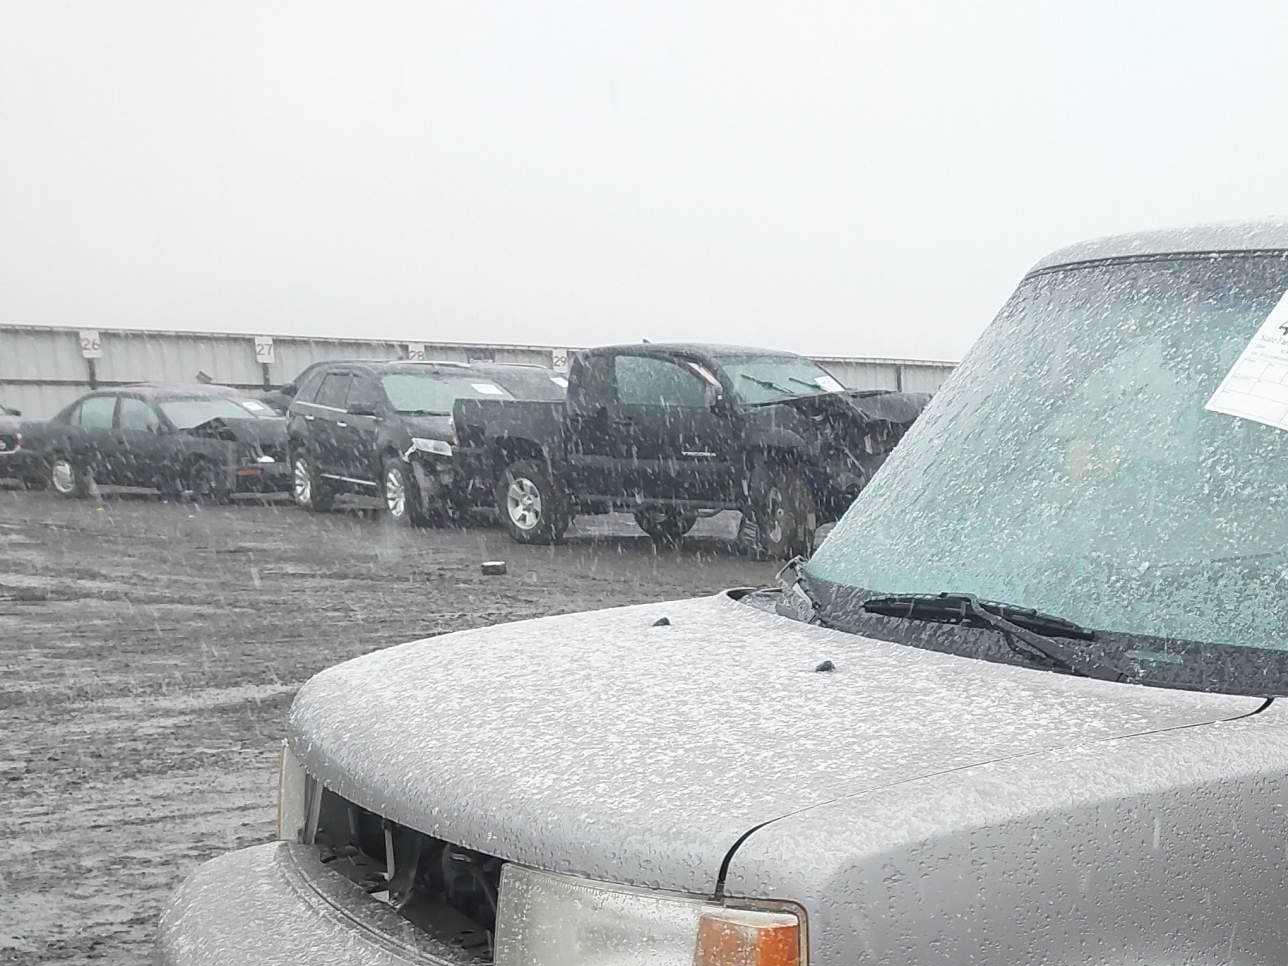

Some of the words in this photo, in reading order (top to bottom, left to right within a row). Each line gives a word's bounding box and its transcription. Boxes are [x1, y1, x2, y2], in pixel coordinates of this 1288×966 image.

[80, 337, 100, 351] 26
[256, 343, 273, 356] 27
[552, 355, 568, 367] 29
